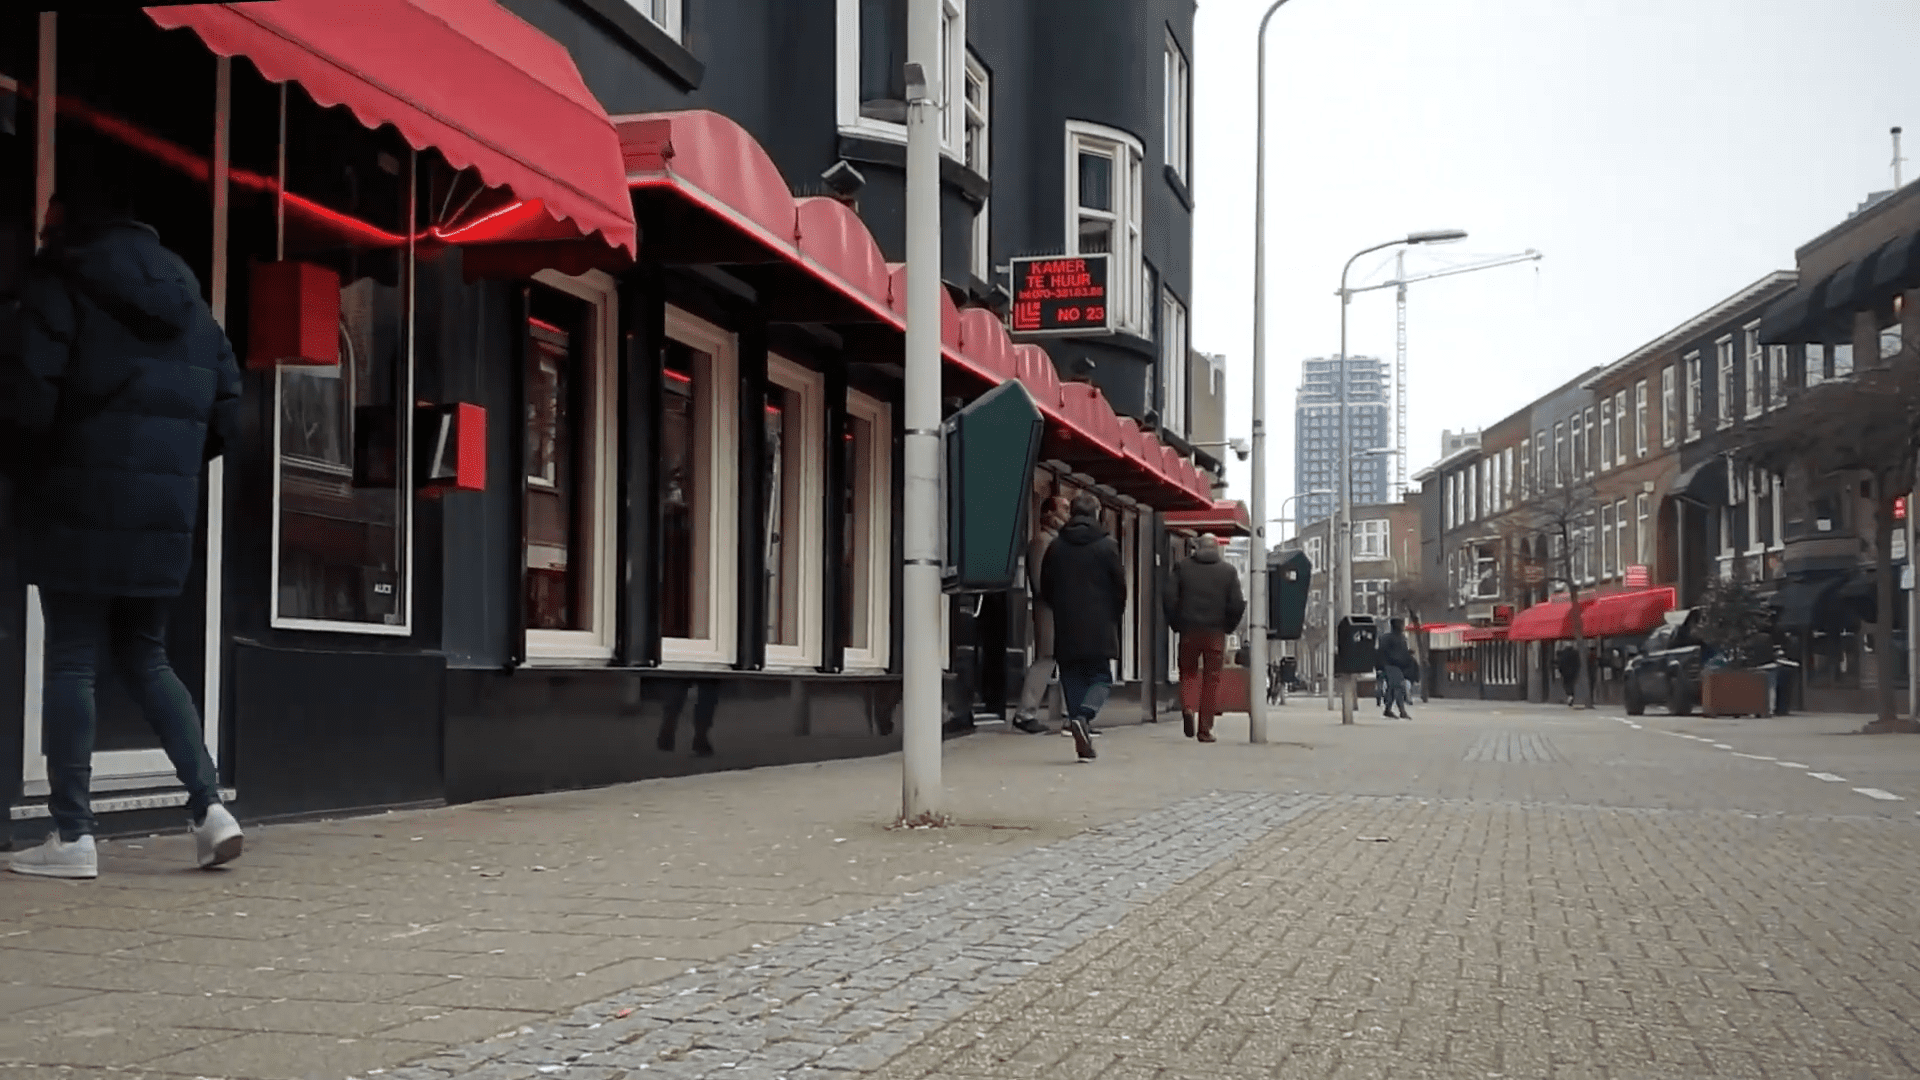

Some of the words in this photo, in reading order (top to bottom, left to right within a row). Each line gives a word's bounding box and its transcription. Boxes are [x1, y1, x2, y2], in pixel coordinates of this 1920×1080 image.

[1031, 259, 1086, 274] KAMER
[1026, 275, 1044, 288] TE
[1050, 273, 1092, 287] HUUR
[1057, 307, 1081, 321] NO
[1086, 306, 1105, 320] 23
